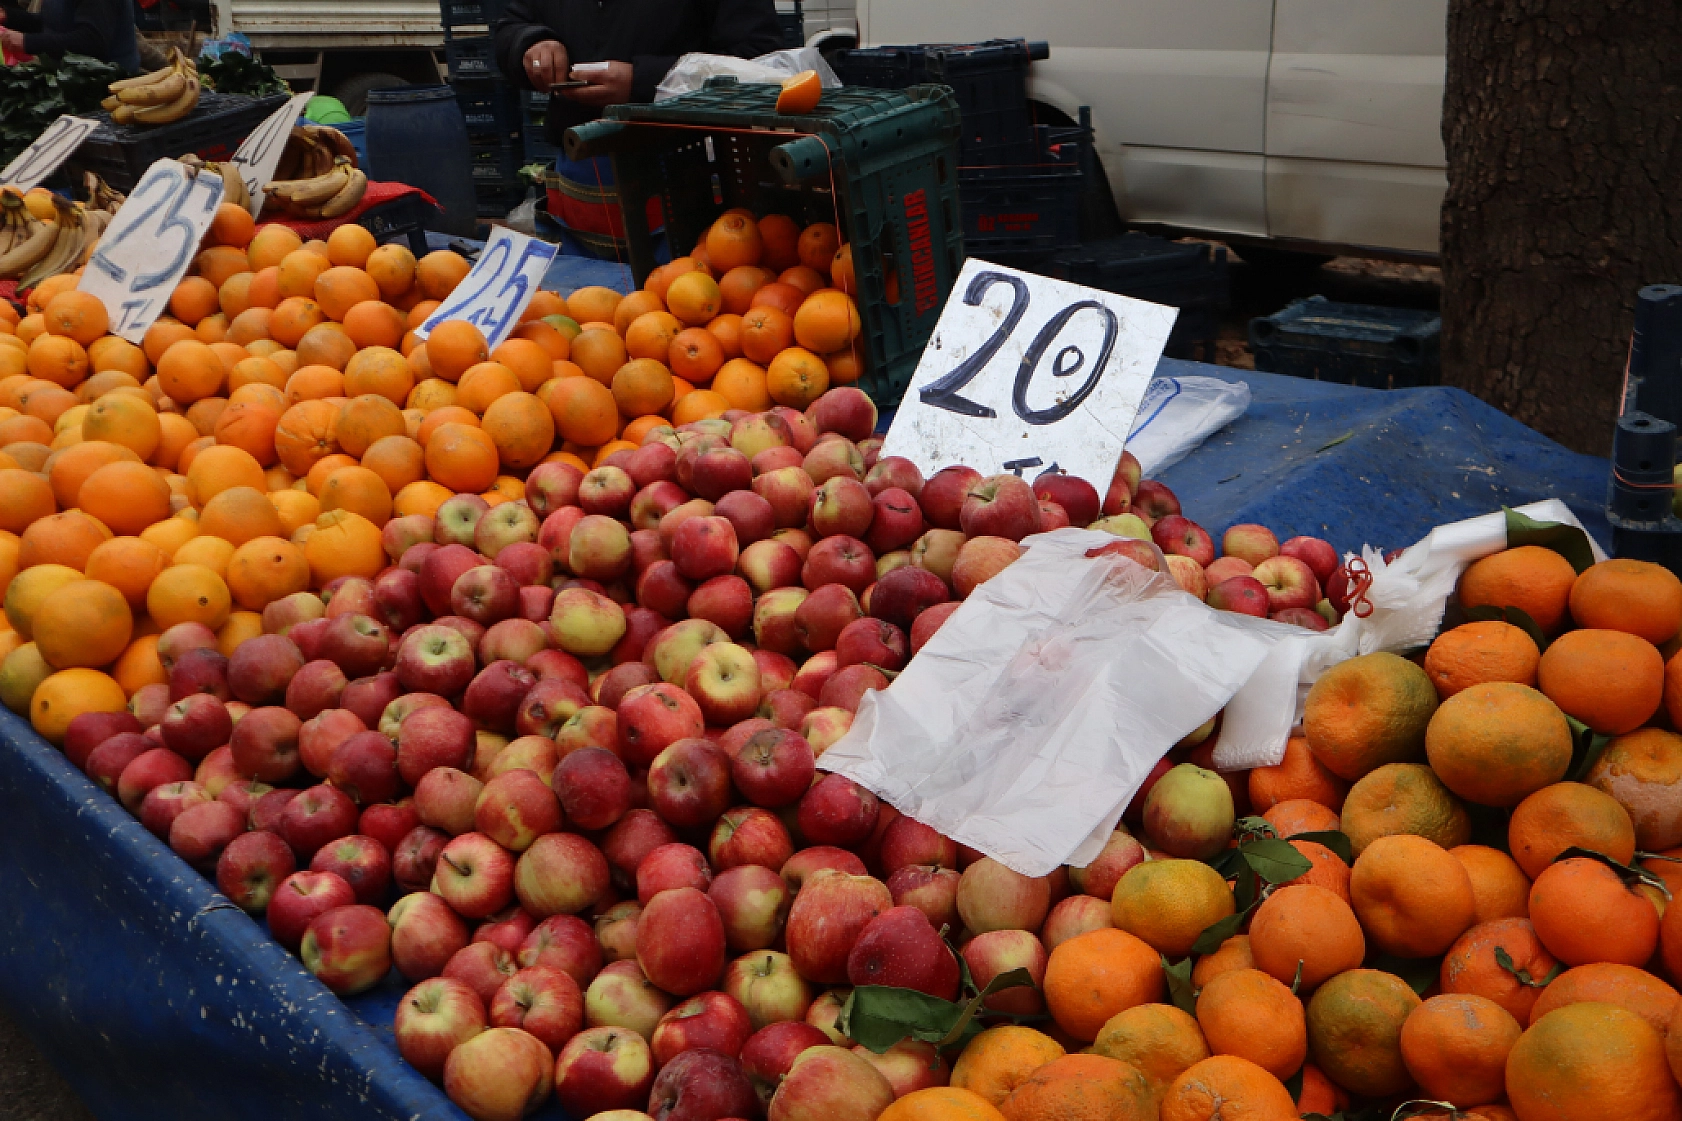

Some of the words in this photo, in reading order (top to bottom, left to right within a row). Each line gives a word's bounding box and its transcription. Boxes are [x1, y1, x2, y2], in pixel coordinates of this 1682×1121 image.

[91, 168, 223, 293] 25
[116, 299, 154, 332] TL
[423, 238, 558, 347] 25
[919, 270, 1119, 425] 20
